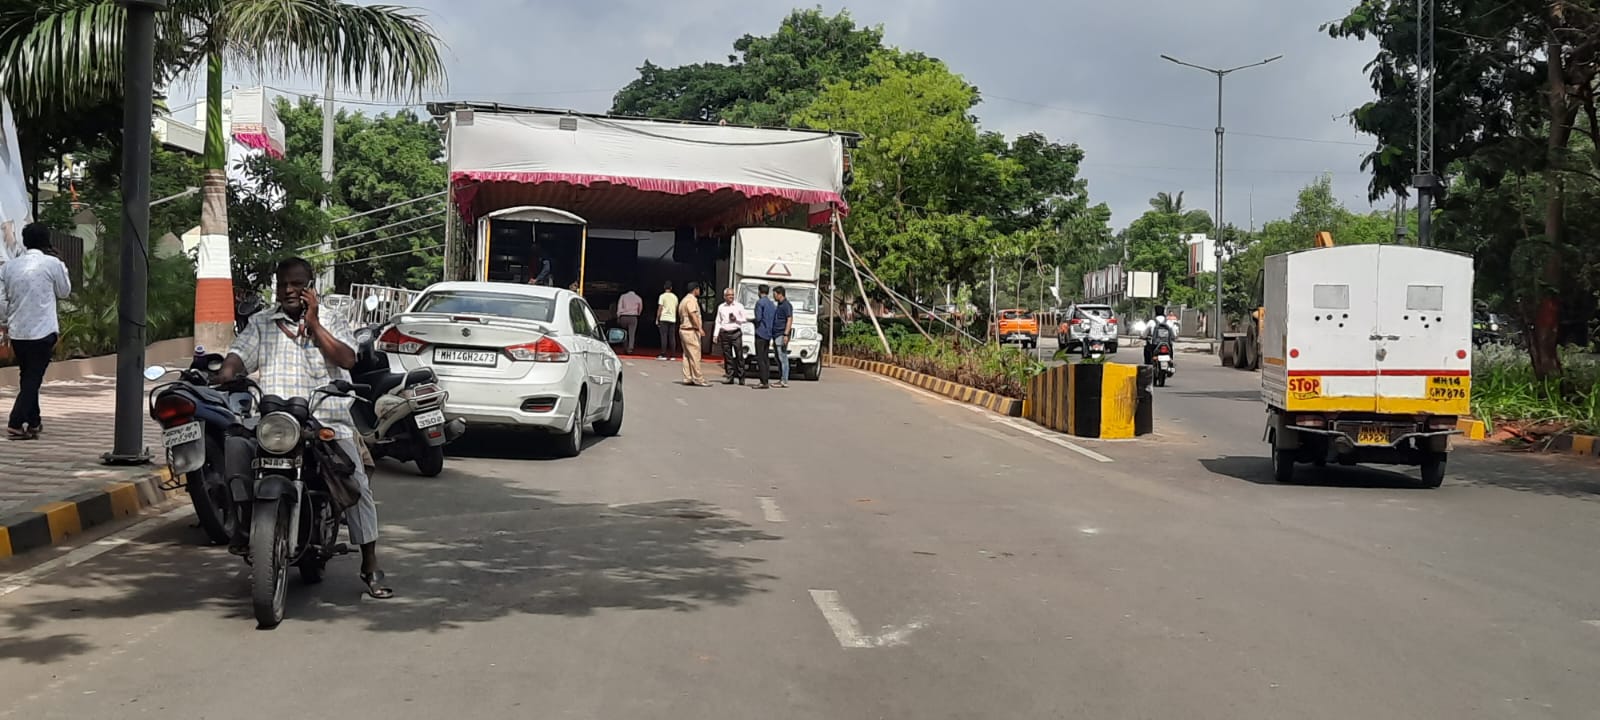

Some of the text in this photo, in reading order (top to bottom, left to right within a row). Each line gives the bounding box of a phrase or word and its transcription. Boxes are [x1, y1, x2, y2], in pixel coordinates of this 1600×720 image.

[440, 351, 495, 362] MH14GH2473
[1288, 377, 1320, 392] STOP
[1432, 376, 1461, 386] MH14
